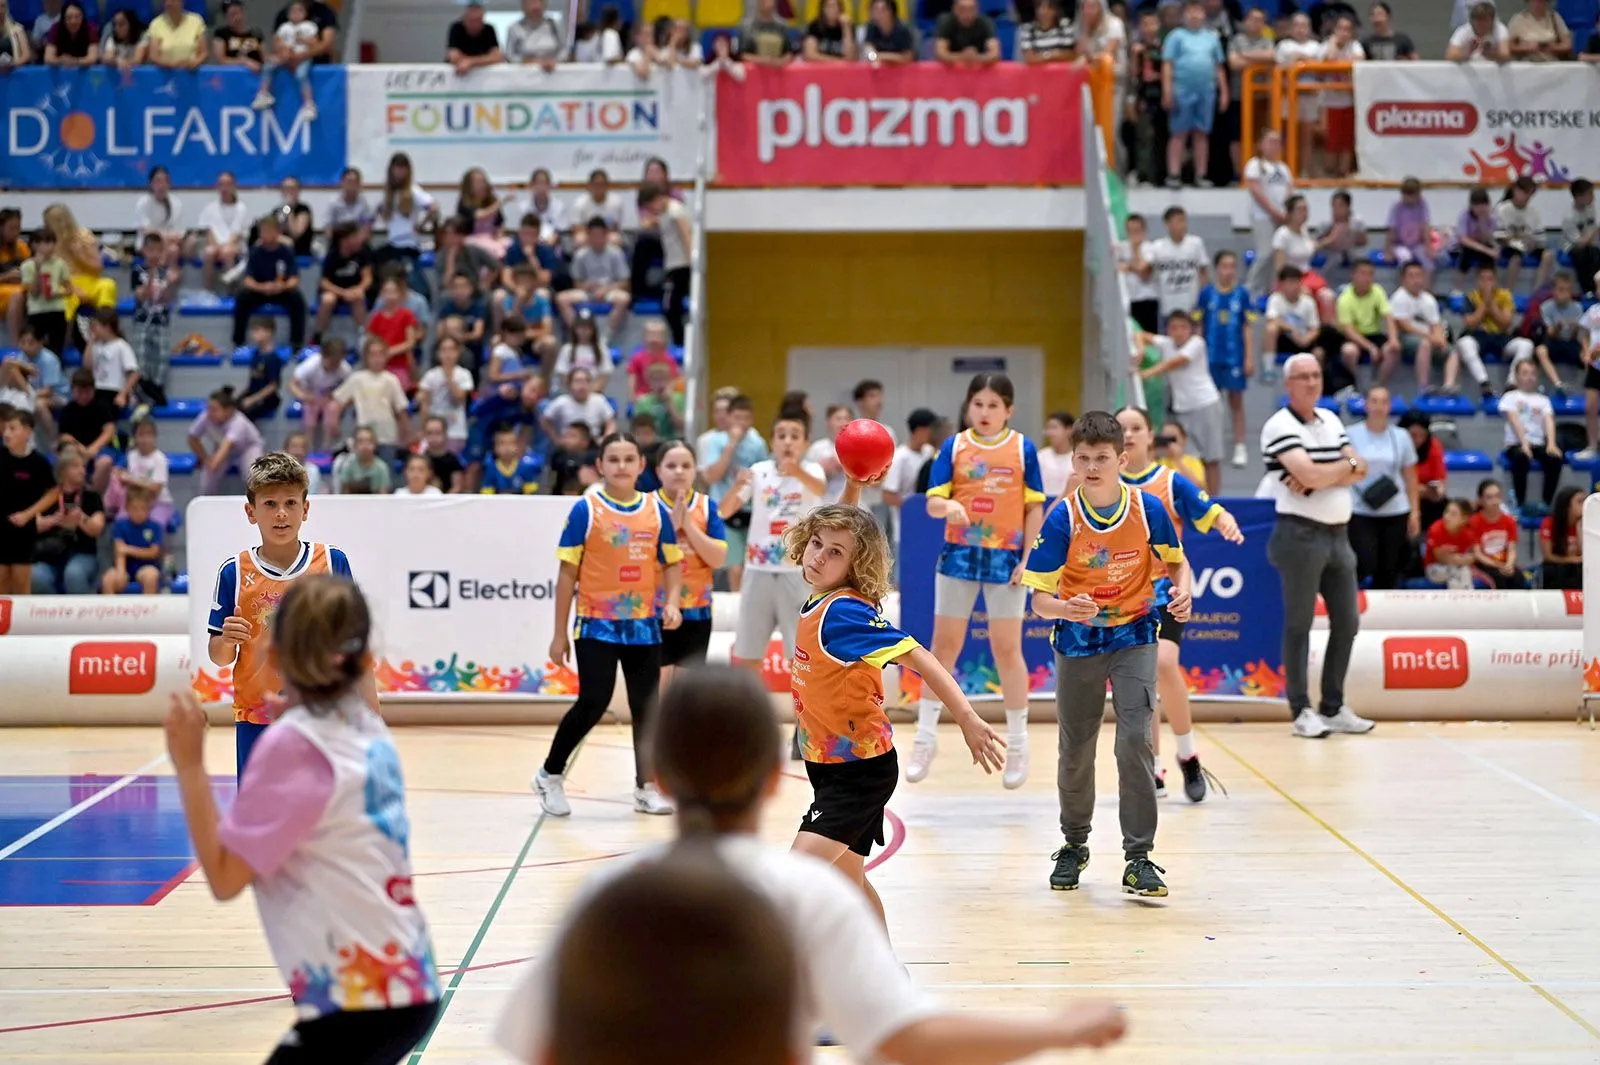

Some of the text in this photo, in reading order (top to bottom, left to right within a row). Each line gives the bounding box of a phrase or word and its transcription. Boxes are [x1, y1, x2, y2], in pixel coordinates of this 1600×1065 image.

[386, 101, 659, 132] FOUNDATION
[758, 83, 1028, 163] plazma
[1375, 105, 1465, 132] plazma
[1486, 109, 1584, 128] SPORTSKE
[459, 579, 554, 600] Electrol
[79, 652, 147, 675] m:tel
[1392, 646, 1460, 670] m:tel
[1490, 649, 1584, 668] imate prij
